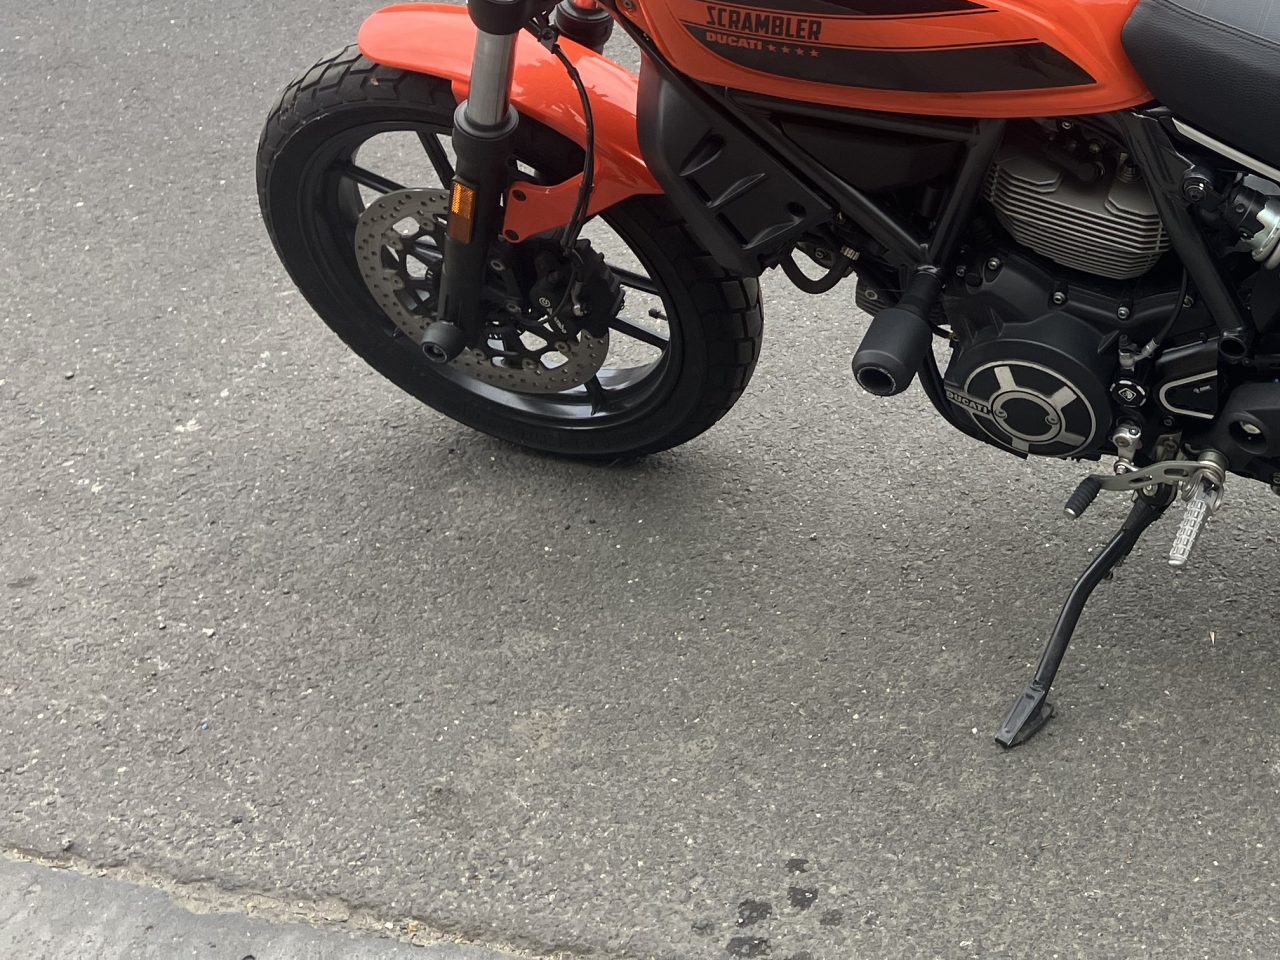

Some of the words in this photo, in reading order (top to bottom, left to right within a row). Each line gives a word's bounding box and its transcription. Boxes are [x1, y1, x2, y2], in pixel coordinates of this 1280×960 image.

[706, 5, 822, 40] SCRAMBLER
[706, 32, 763, 50] DUCATI
[945, 390, 989, 414] DUCATI
